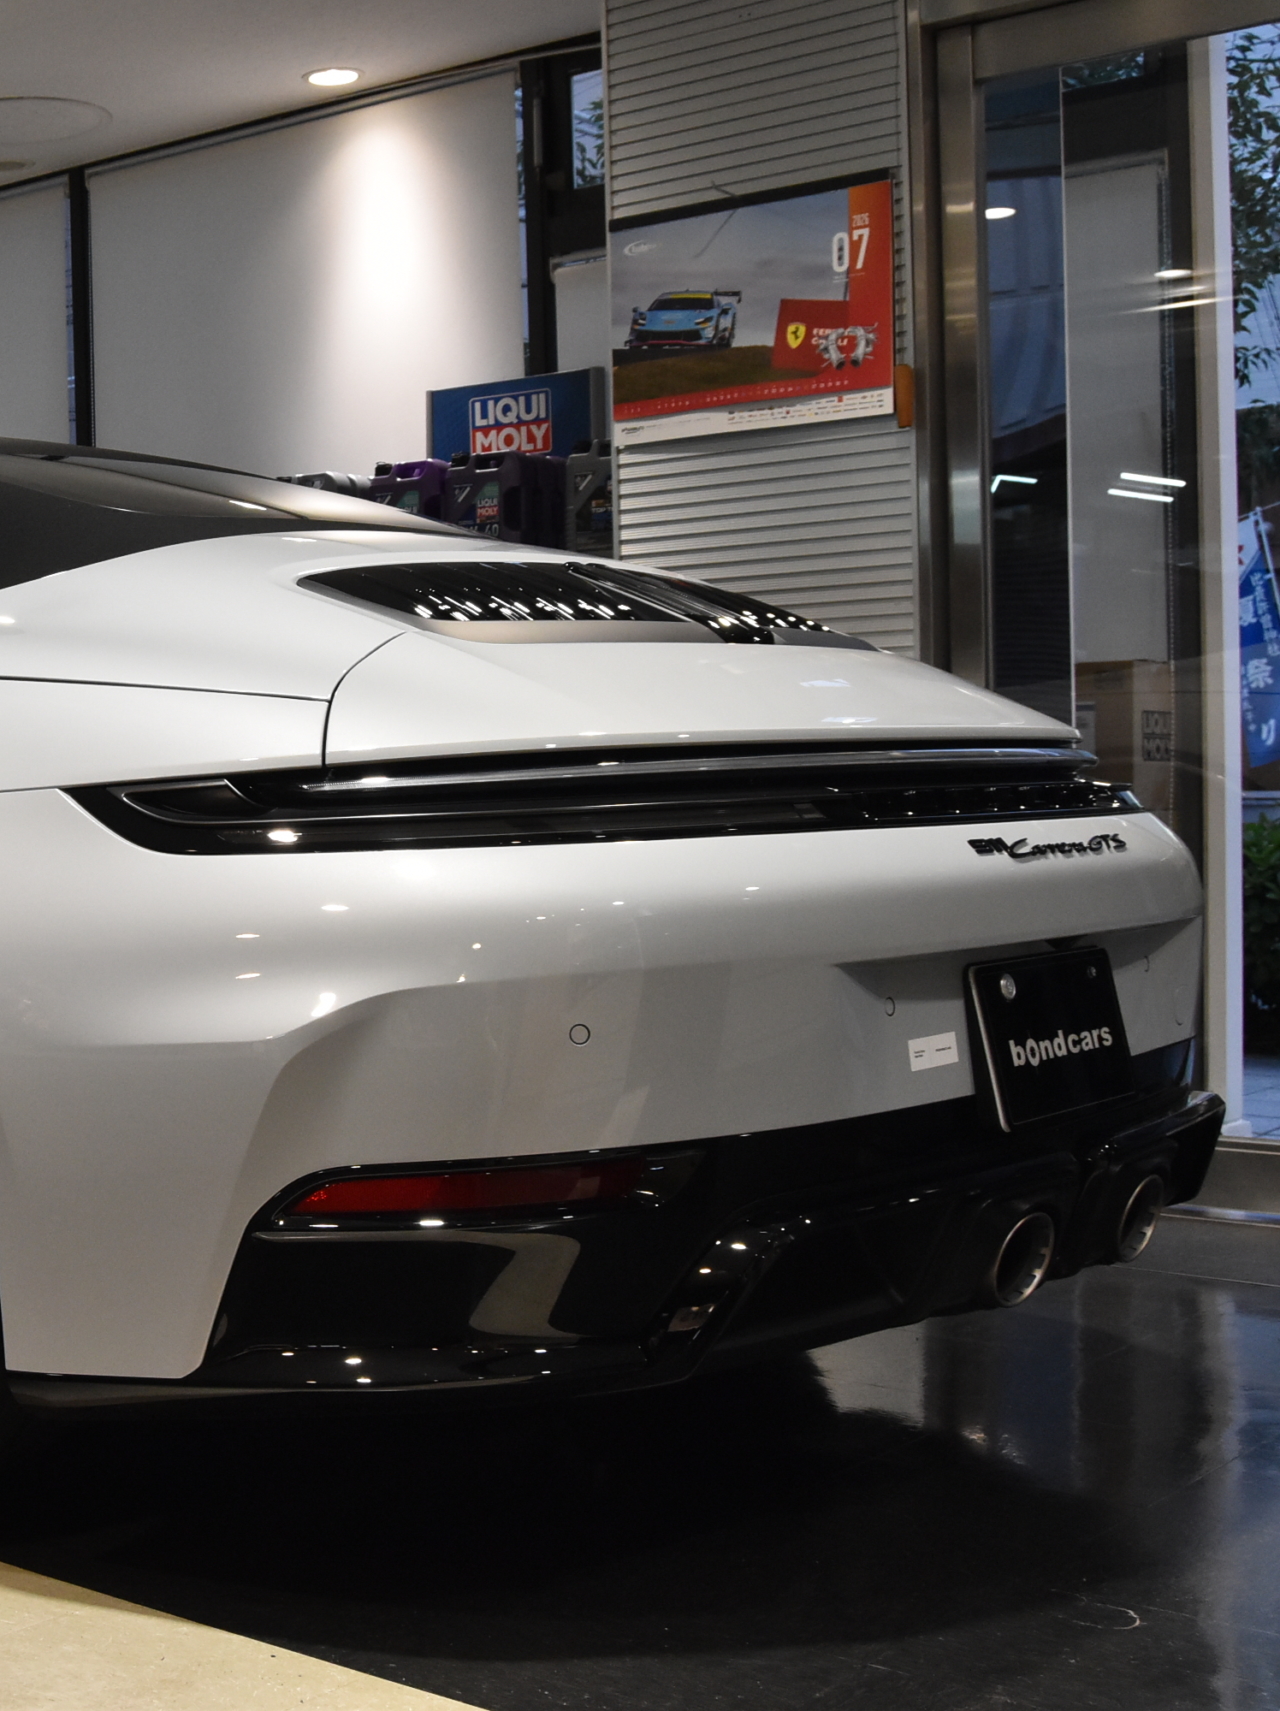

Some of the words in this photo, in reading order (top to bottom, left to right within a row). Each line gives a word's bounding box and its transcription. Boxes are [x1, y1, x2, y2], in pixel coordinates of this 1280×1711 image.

[832, 228, 870, 273] 07
[474, 393, 546, 427] LIQUI
[475, 423, 549, 454] MOLY
[477, 498, 498, 508] LIQUI
[477, 506, 499, 518] MOLY
[1009, 838, 1090, 859] Carrera
[1088, 833, 1127, 853] GTS
